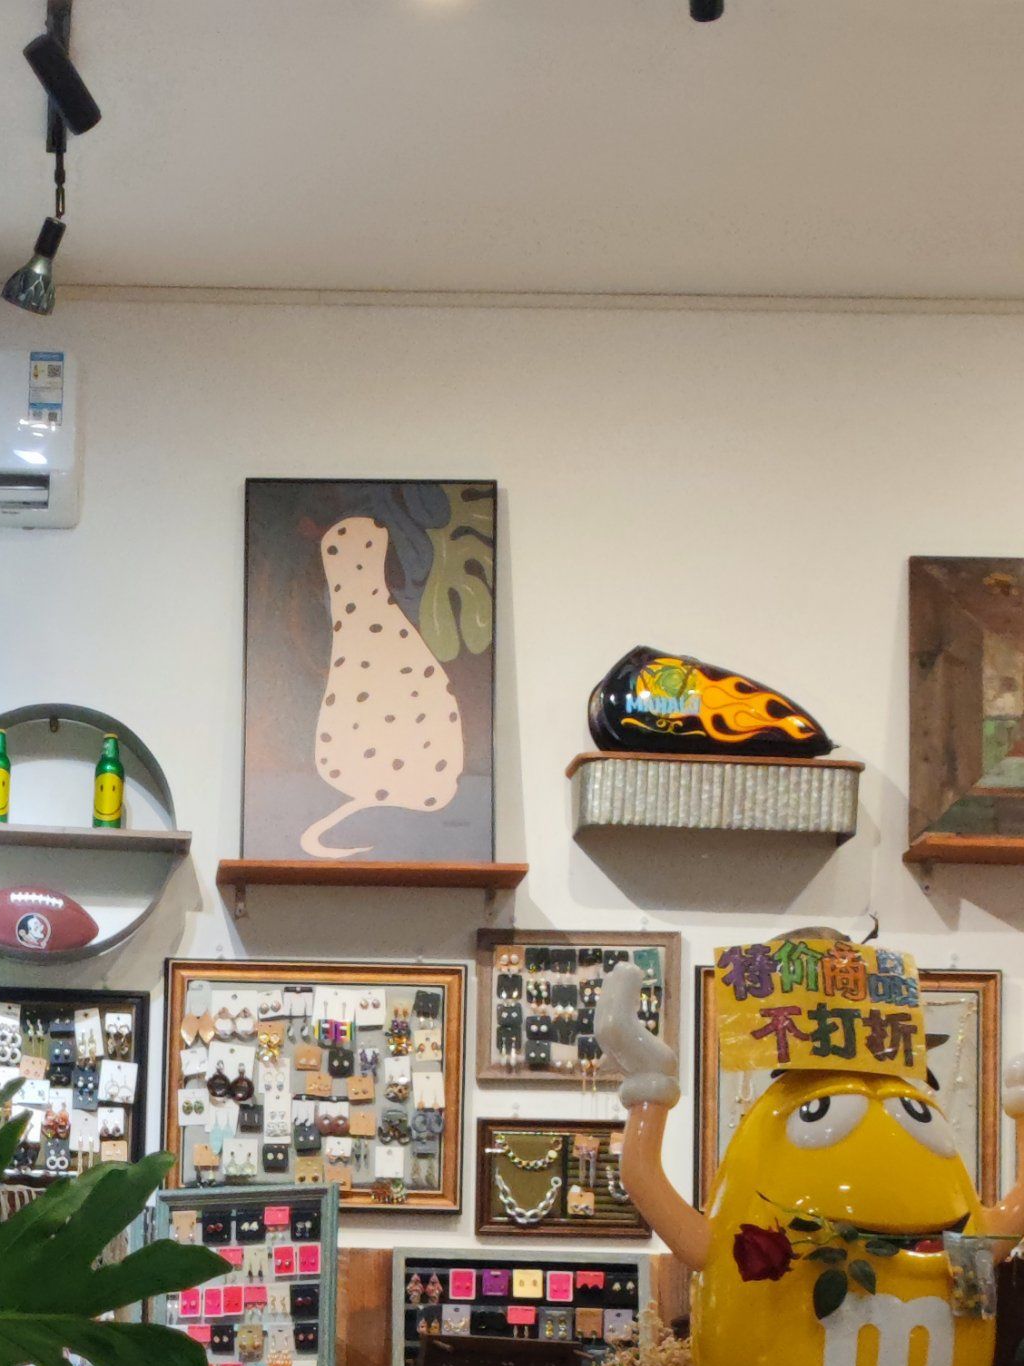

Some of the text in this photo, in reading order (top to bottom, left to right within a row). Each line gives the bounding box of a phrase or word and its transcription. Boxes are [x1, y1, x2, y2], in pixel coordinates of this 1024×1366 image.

[717, 940, 920, 1008] 特价商品
[750, 1003, 918, 1067] 不打折
